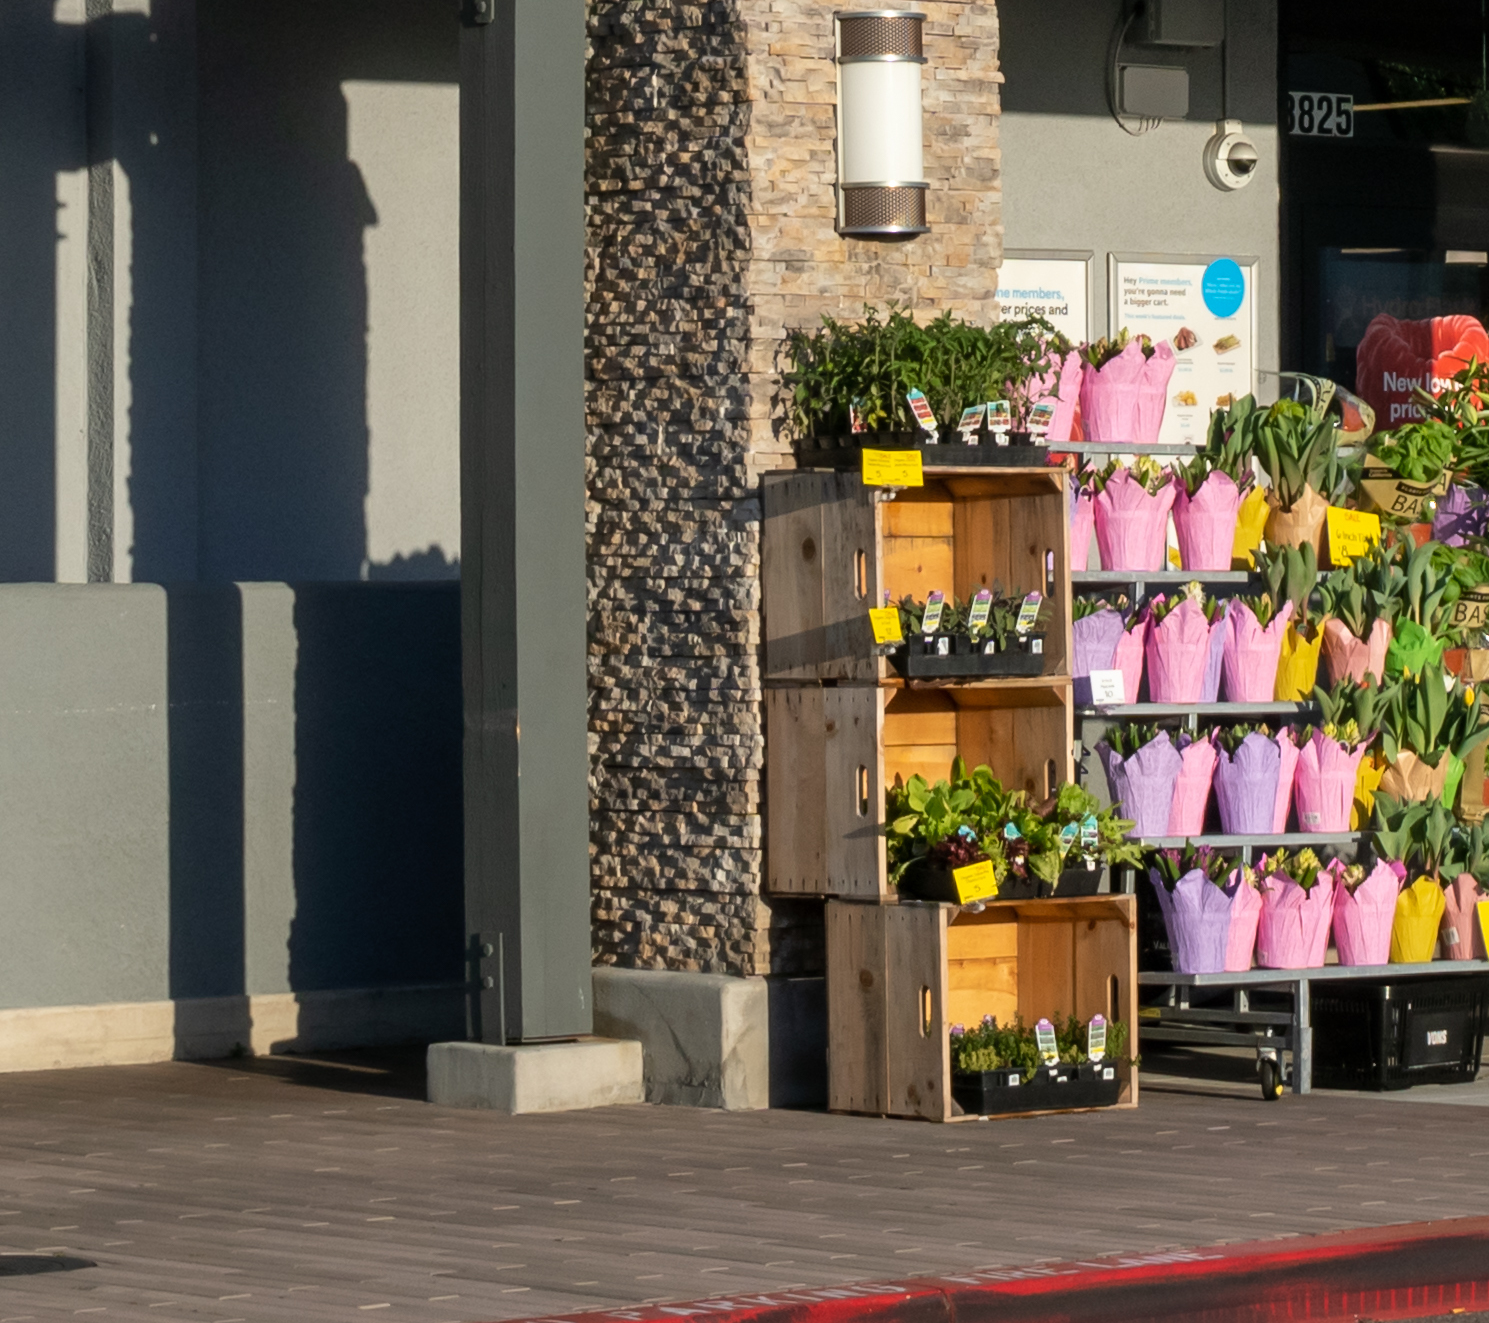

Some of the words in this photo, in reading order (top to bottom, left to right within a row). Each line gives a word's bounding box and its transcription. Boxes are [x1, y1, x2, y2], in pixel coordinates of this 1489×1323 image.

[1123, 276, 1137, 285] Hey
[1138, 276, 1158, 285] Prime
[1012, 286, 1064, 301] members,
[1123, 287, 1145, 297] you're
[1146, 289, 1168, 297] gonna
[1169, 288, 1186, 296] need
[1014, 302, 1046, 317] prices
[1048, 303, 1068, 315] and
[1129, 298, 1152, 307] bigger
[1153, 298, 1169, 306] cart.
[1383, 371, 1422, 392] New
[939, 1263, 1079, 1284] FIRE
[1074, 1250, 1225, 1269] LANE
[603, 1284, 907, 1321] PARKING
